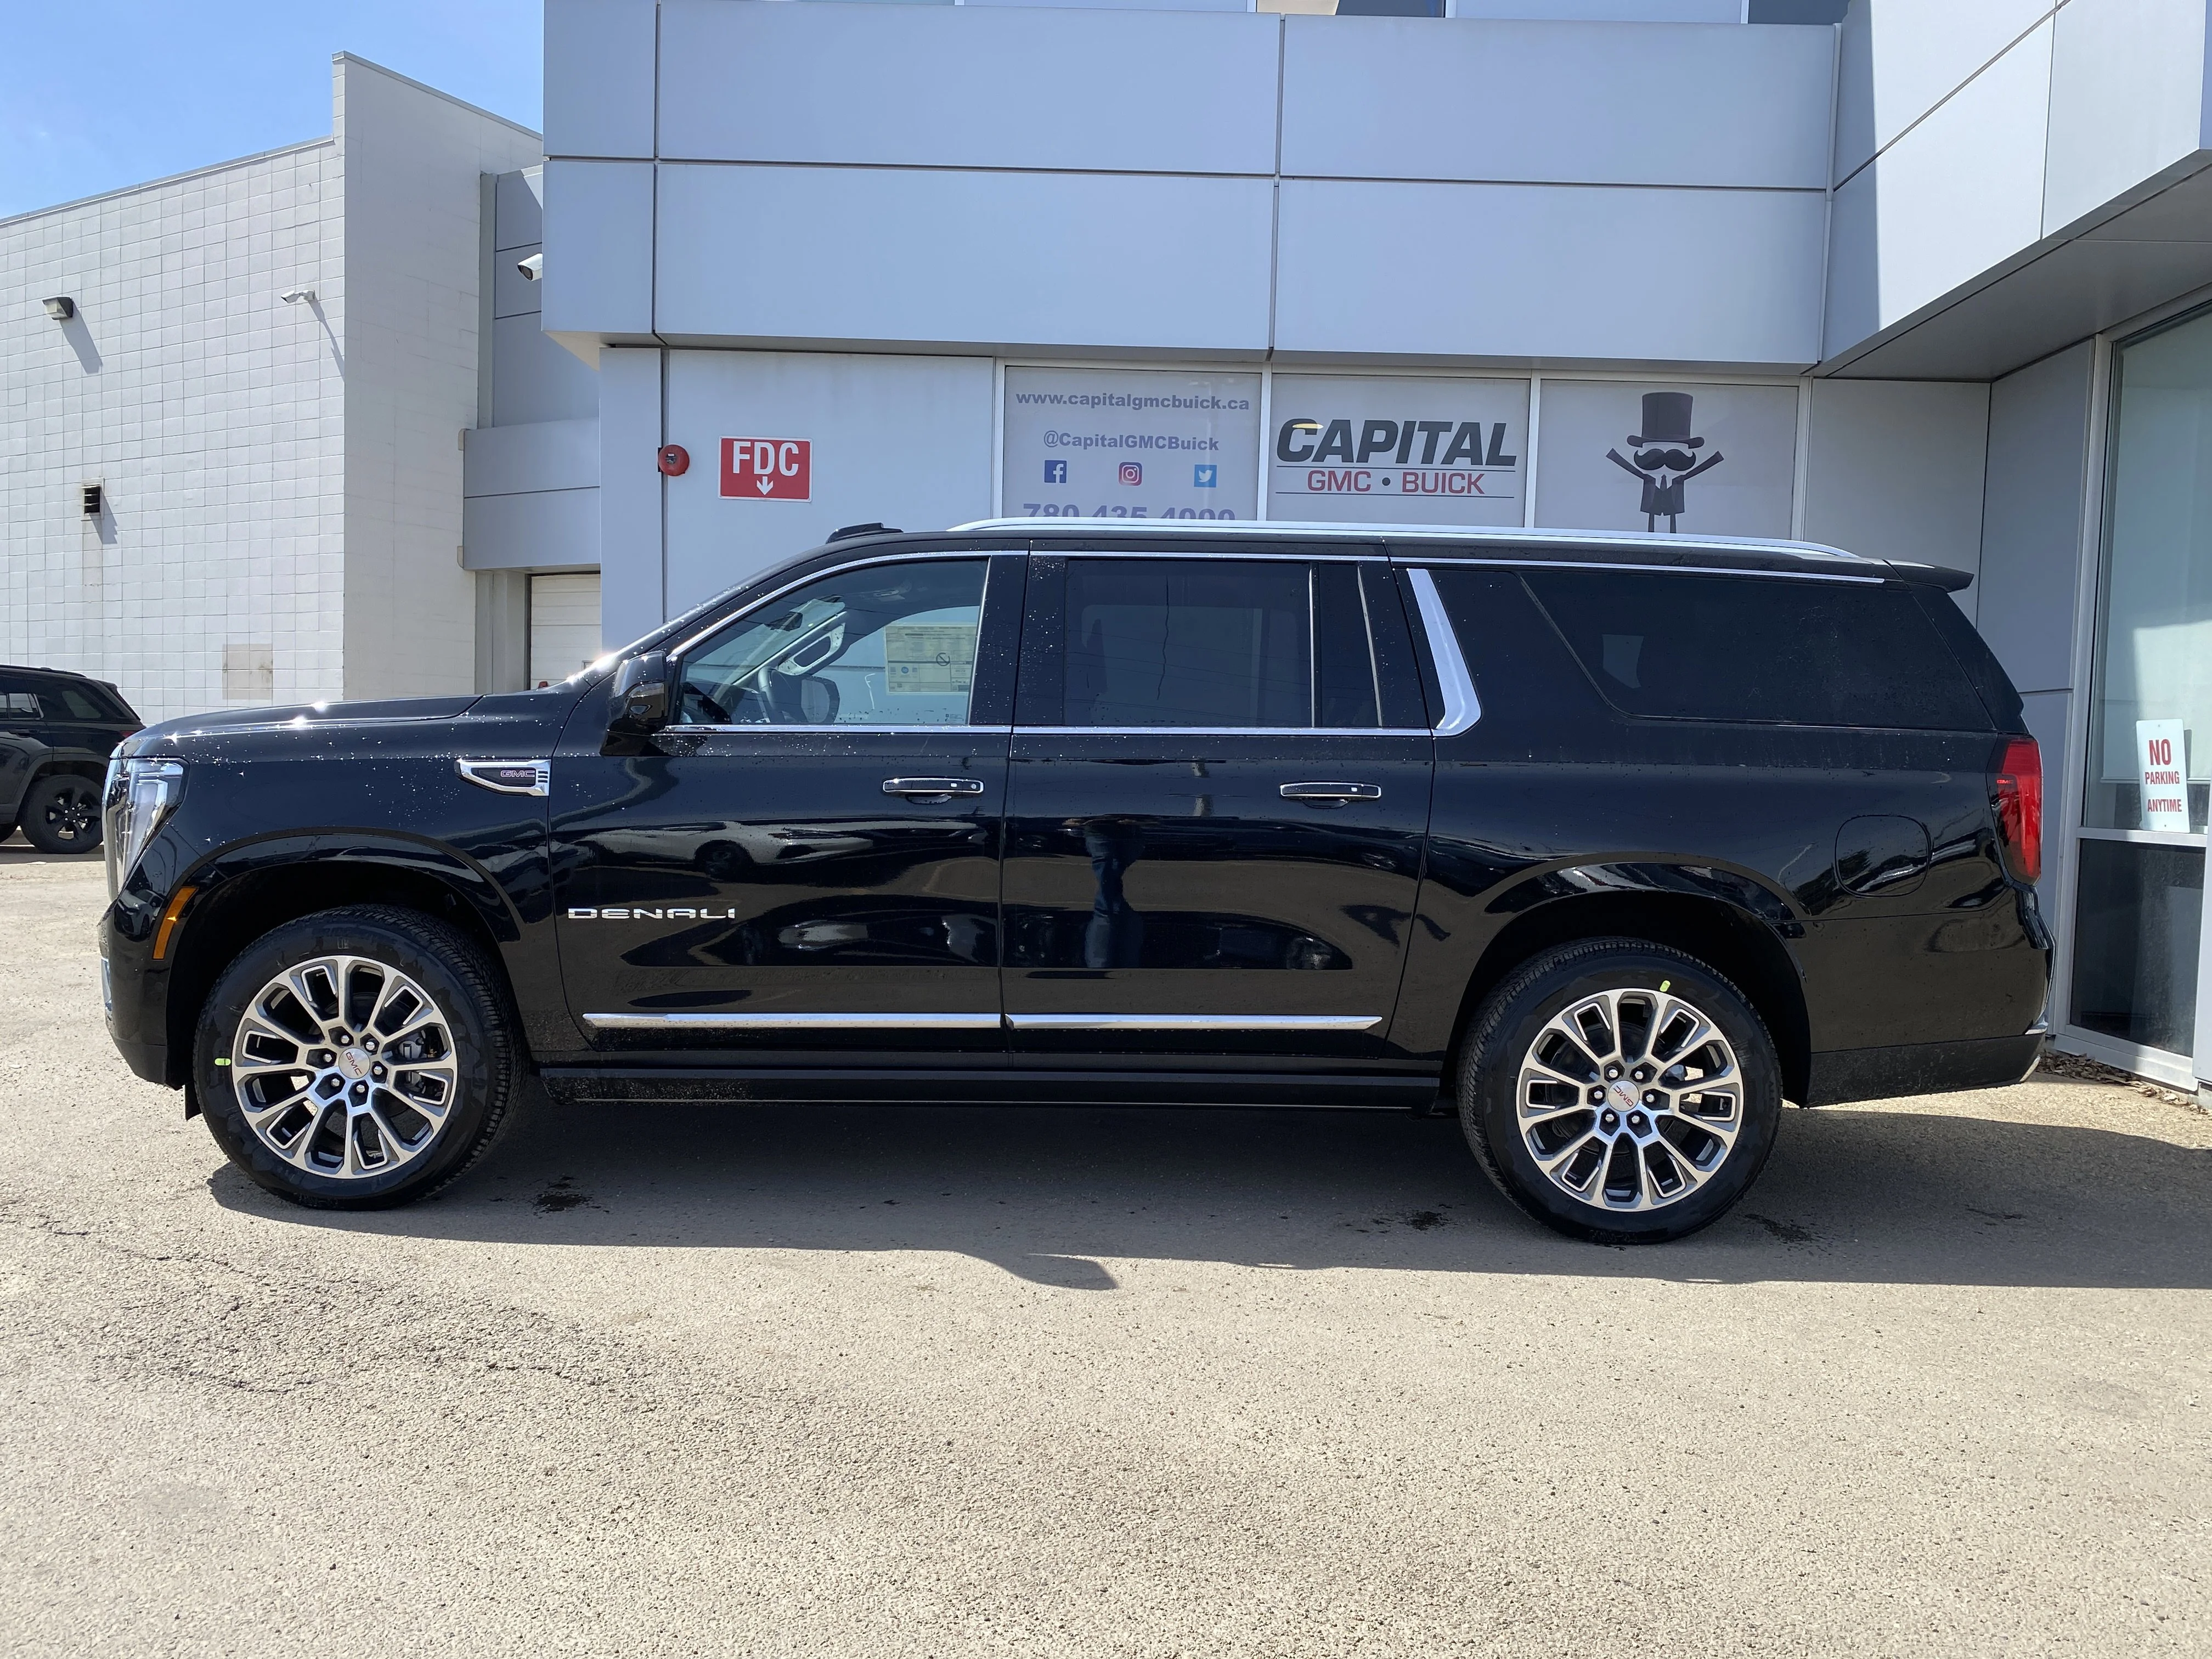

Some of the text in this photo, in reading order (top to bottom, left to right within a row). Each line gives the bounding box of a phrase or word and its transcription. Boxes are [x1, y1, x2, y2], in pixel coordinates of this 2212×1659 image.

[1015, 392, 1250, 410] www.capitalgmcbuick.ca
[1043, 430, 1219, 451] @CapitalGMCBuick
[1277, 418, 1516, 466] CAPITAL
[732, 441, 799, 476] FDC
[1307, 470, 1485, 494] GMC BUICK
[2148, 739, 2172, 765] NO
[2145, 771, 2180, 785] PARKING
[2147, 799, 2182, 812] ANYTIME
[568, 908, 735, 919] DENALI
[346, 1052, 362, 1076] GMC
[1613, 1085, 1634, 1107] GMC
